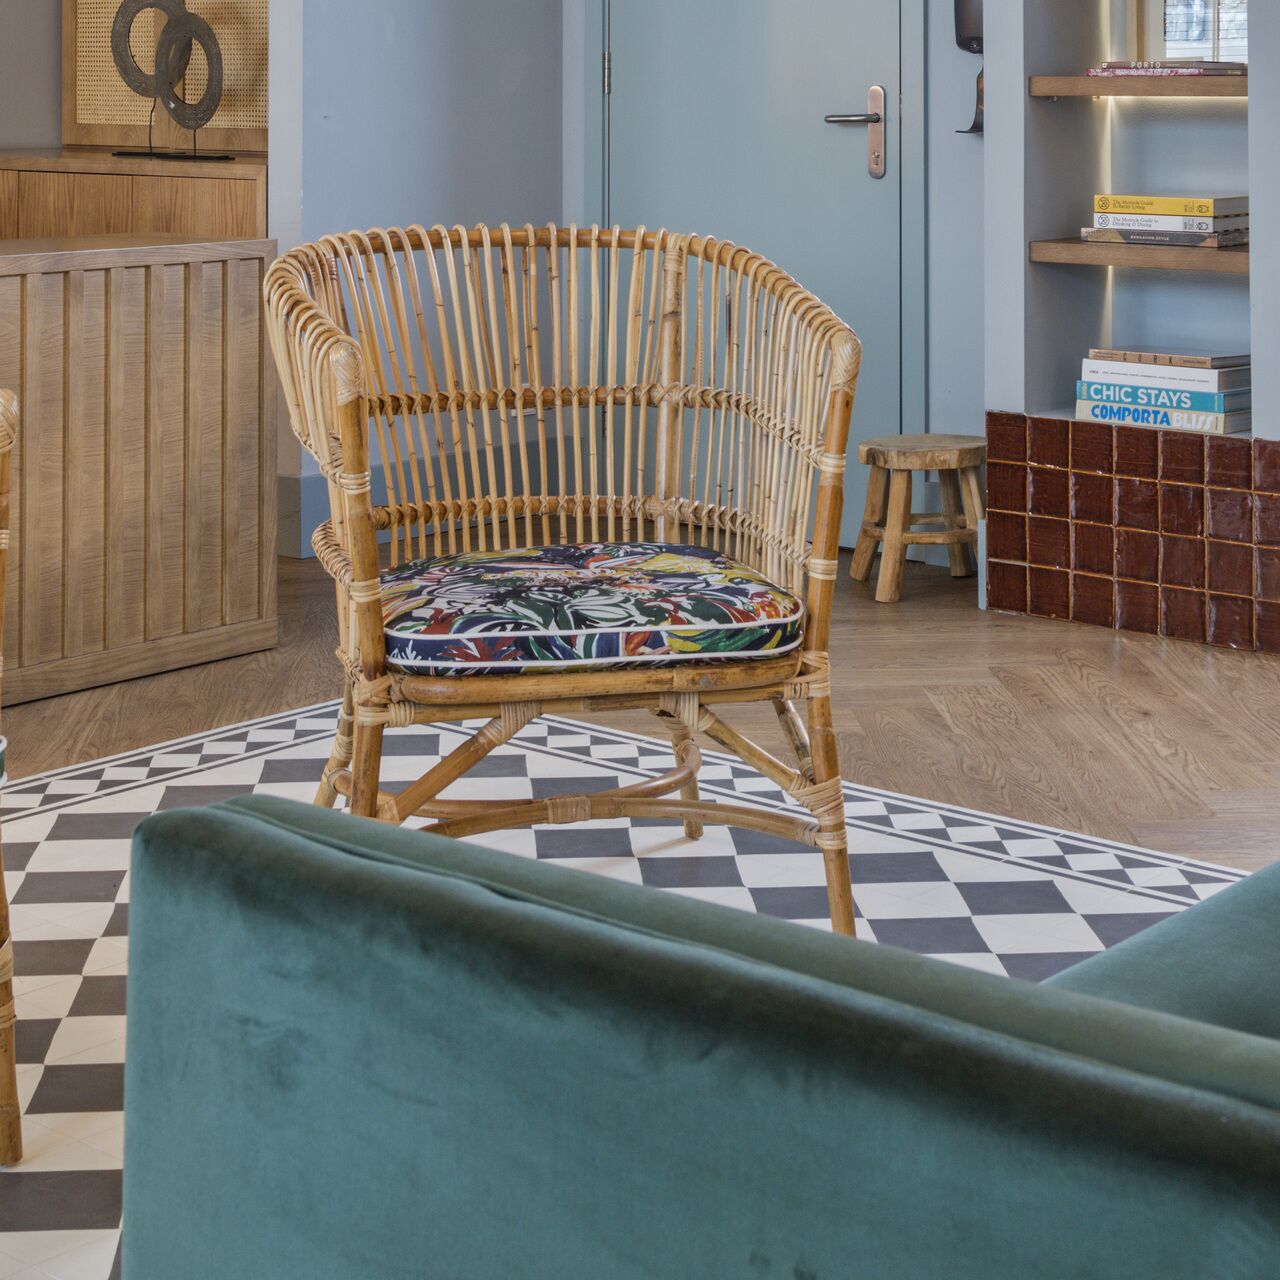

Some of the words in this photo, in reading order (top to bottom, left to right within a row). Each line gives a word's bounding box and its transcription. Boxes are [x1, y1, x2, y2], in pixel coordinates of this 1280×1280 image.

[1089, 384, 1132, 402] CHIC
[1137, 388, 1191, 408] STAYS
[1091, 405, 1171, 425] COMPORTA
[1173, 412, 1213, 431] BLISS
